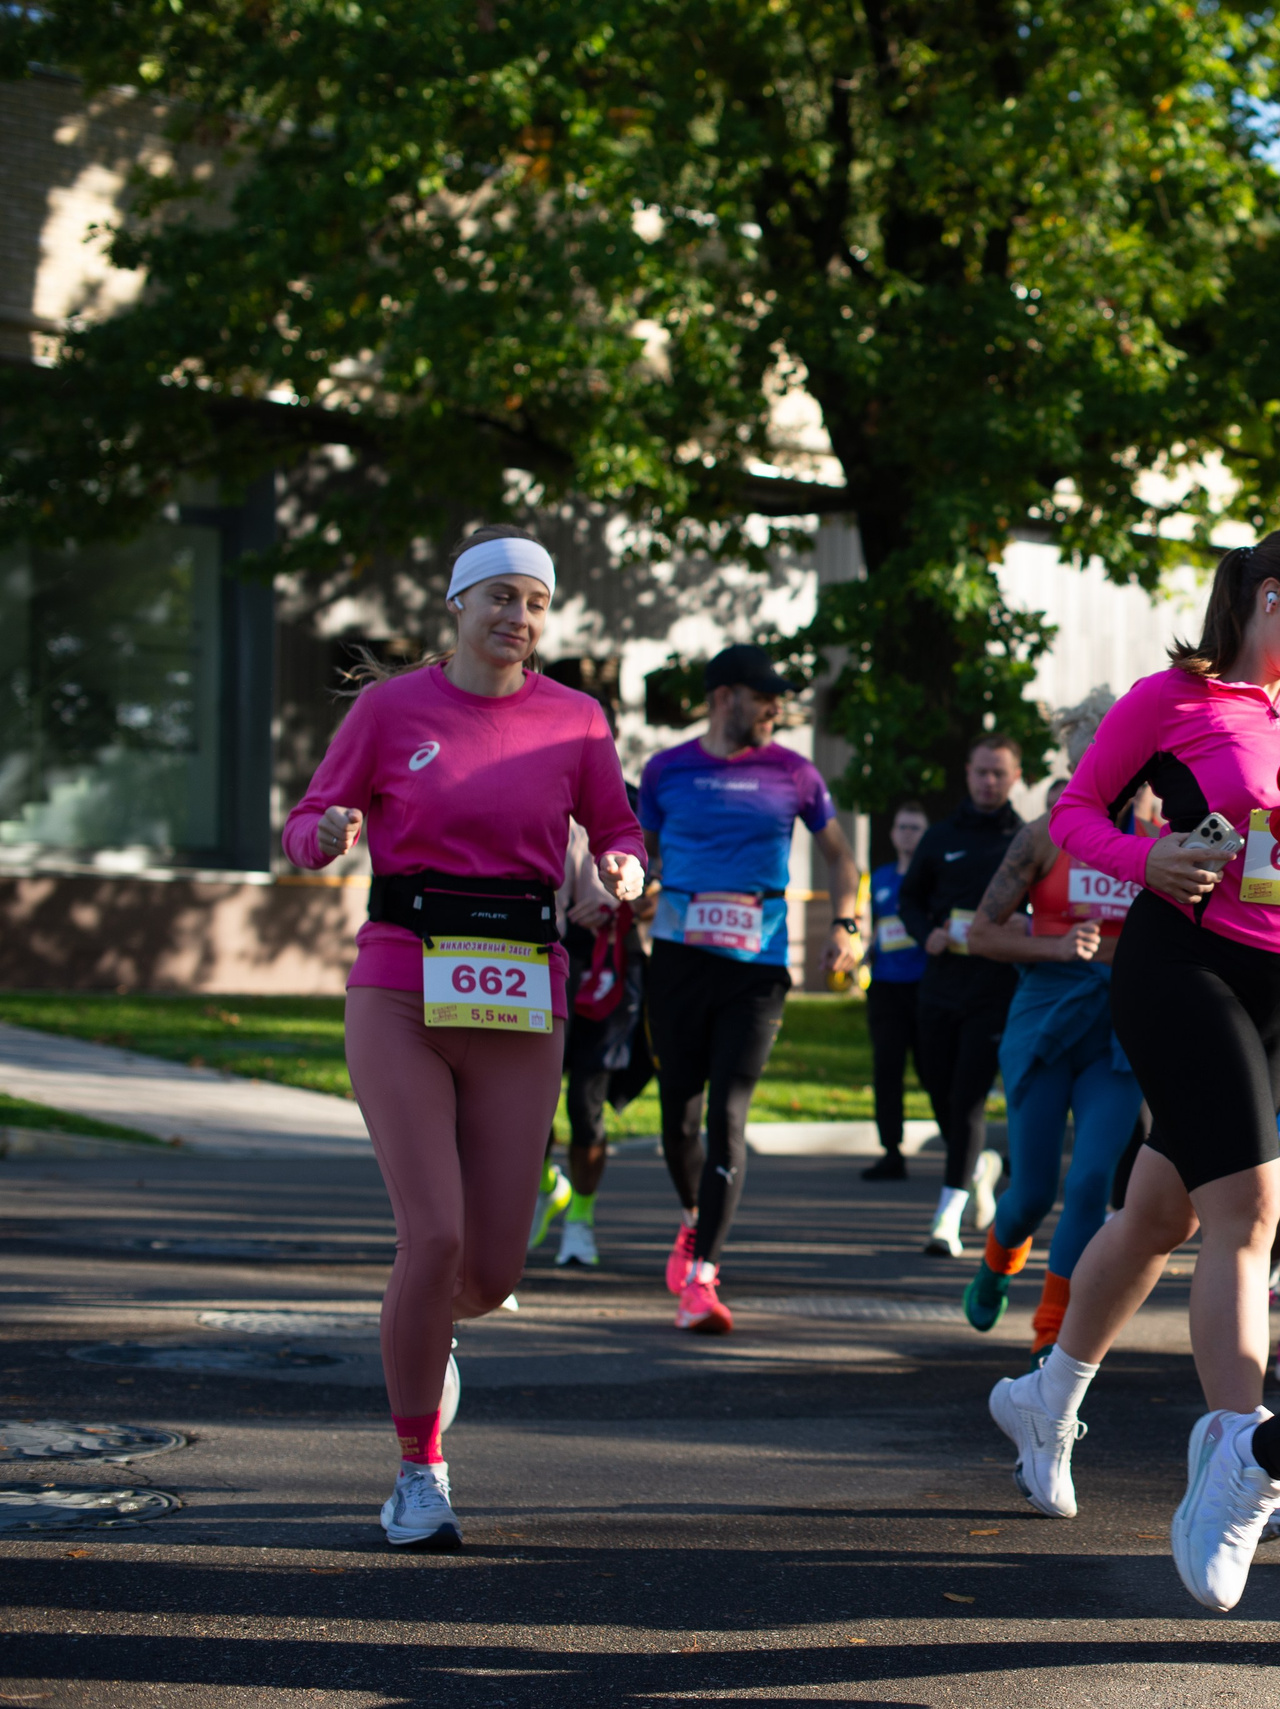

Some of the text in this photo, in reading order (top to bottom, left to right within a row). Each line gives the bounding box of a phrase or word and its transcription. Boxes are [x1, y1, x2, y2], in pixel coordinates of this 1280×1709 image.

[697, 907, 755, 930] 1053
[440, 941, 532, 957] ИНКЛЮЗИВНЫЙ ЗАБЕГ
[451, 964, 527, 998] 662
[471, 1008, 495, 1023] 5,5
